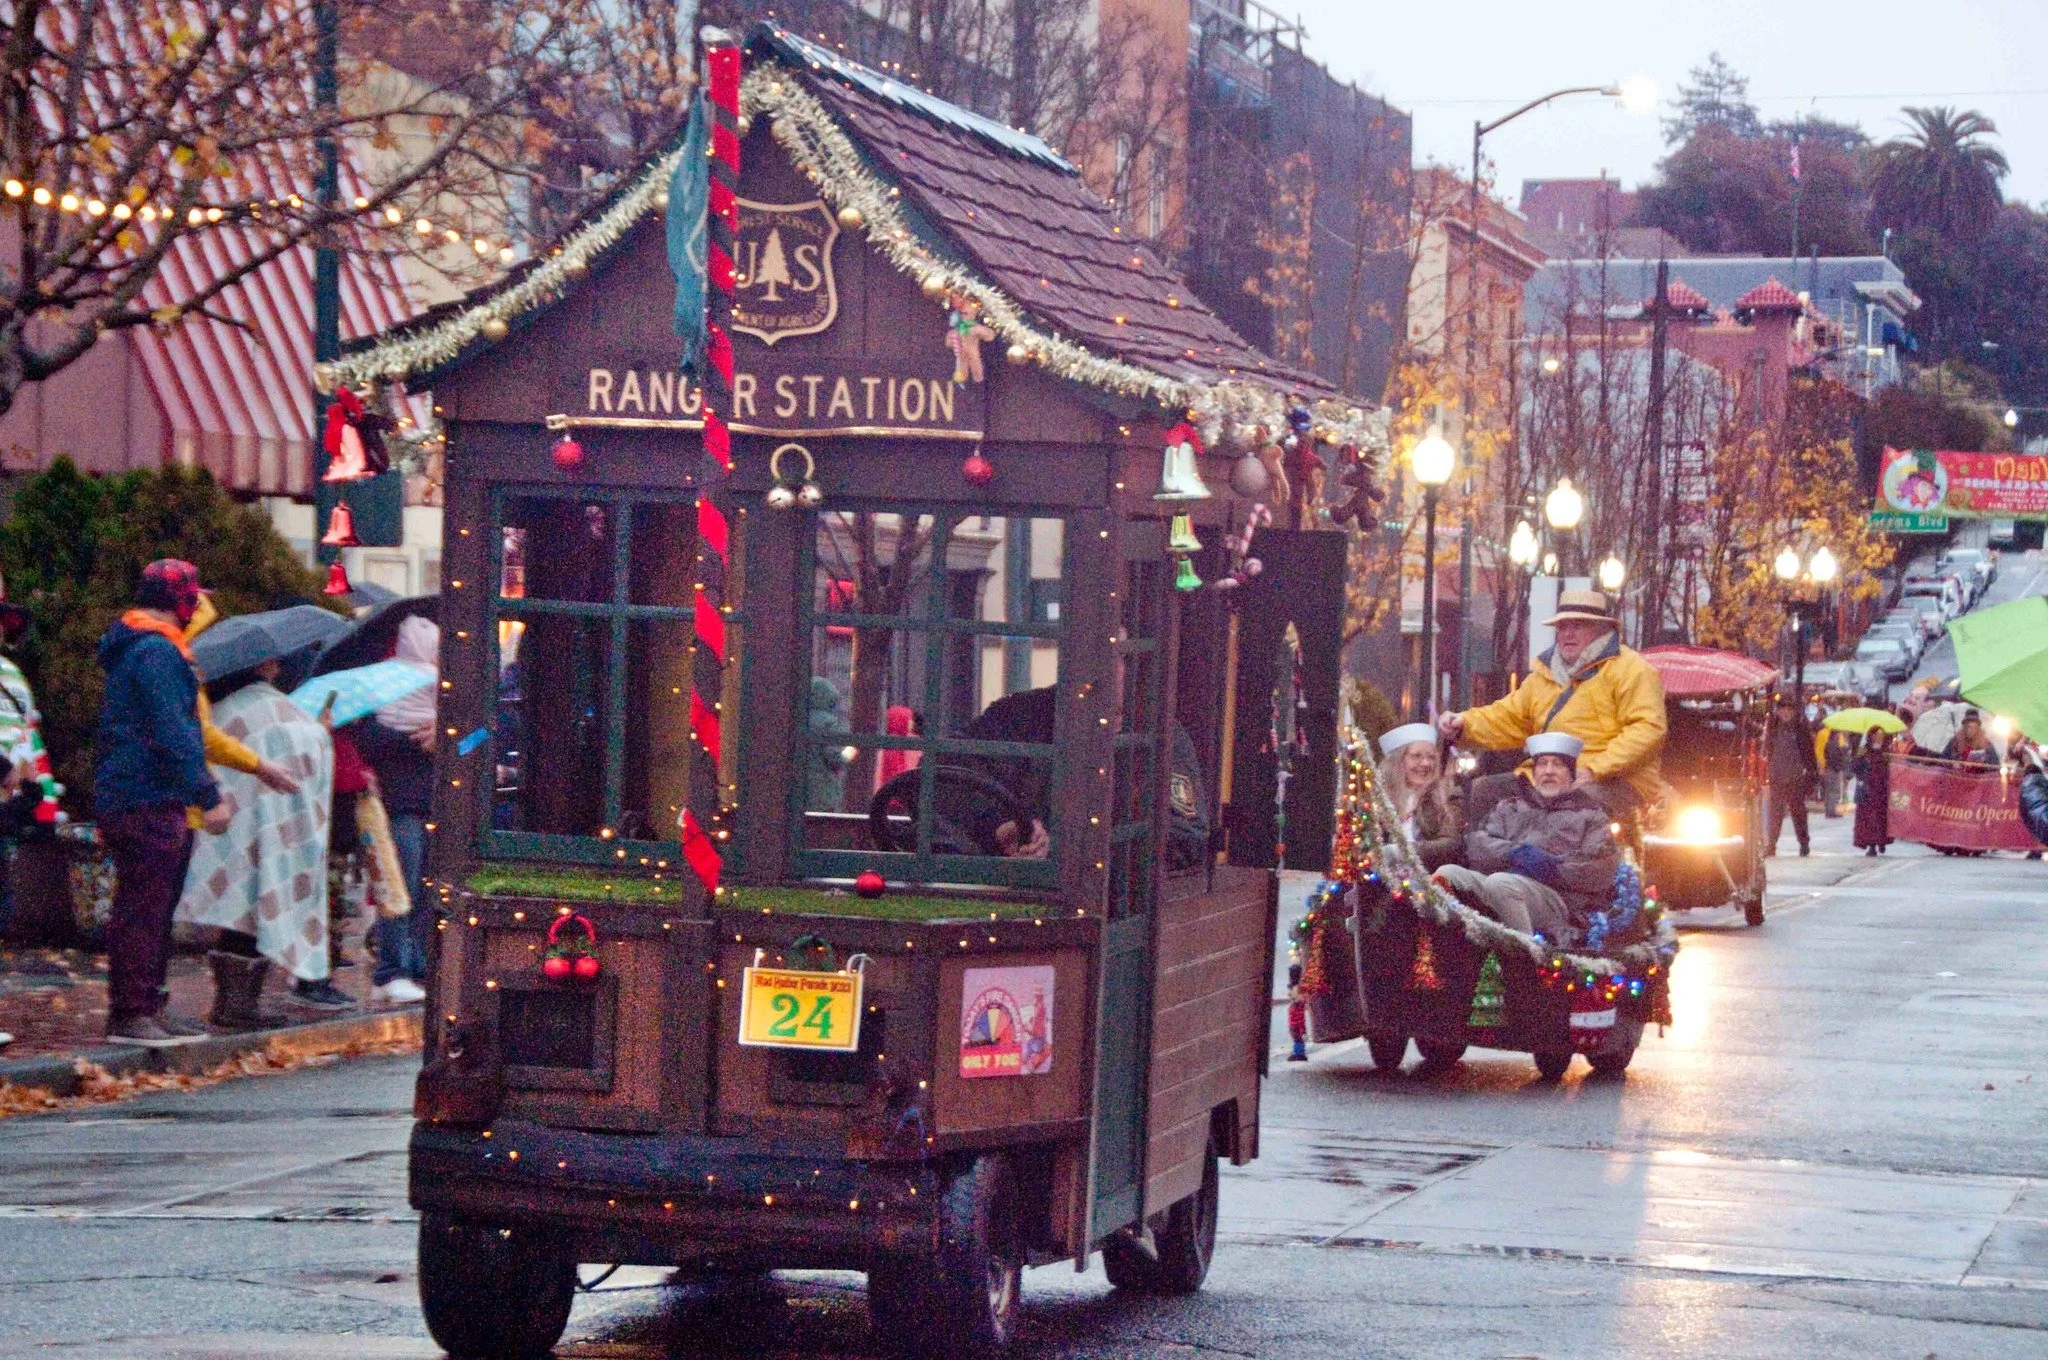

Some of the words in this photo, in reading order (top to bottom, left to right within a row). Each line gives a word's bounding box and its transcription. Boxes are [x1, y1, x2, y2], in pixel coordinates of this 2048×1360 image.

[793, 244, 821, 292] S
[588, 368, 757, 419] RANGR
[774, 374, 955, 422] STATION
[1920, 797, 1974, 821] Verismo
[1975, 805, 2019, 828] Opera
[768, 992, 834, 1039] 24
